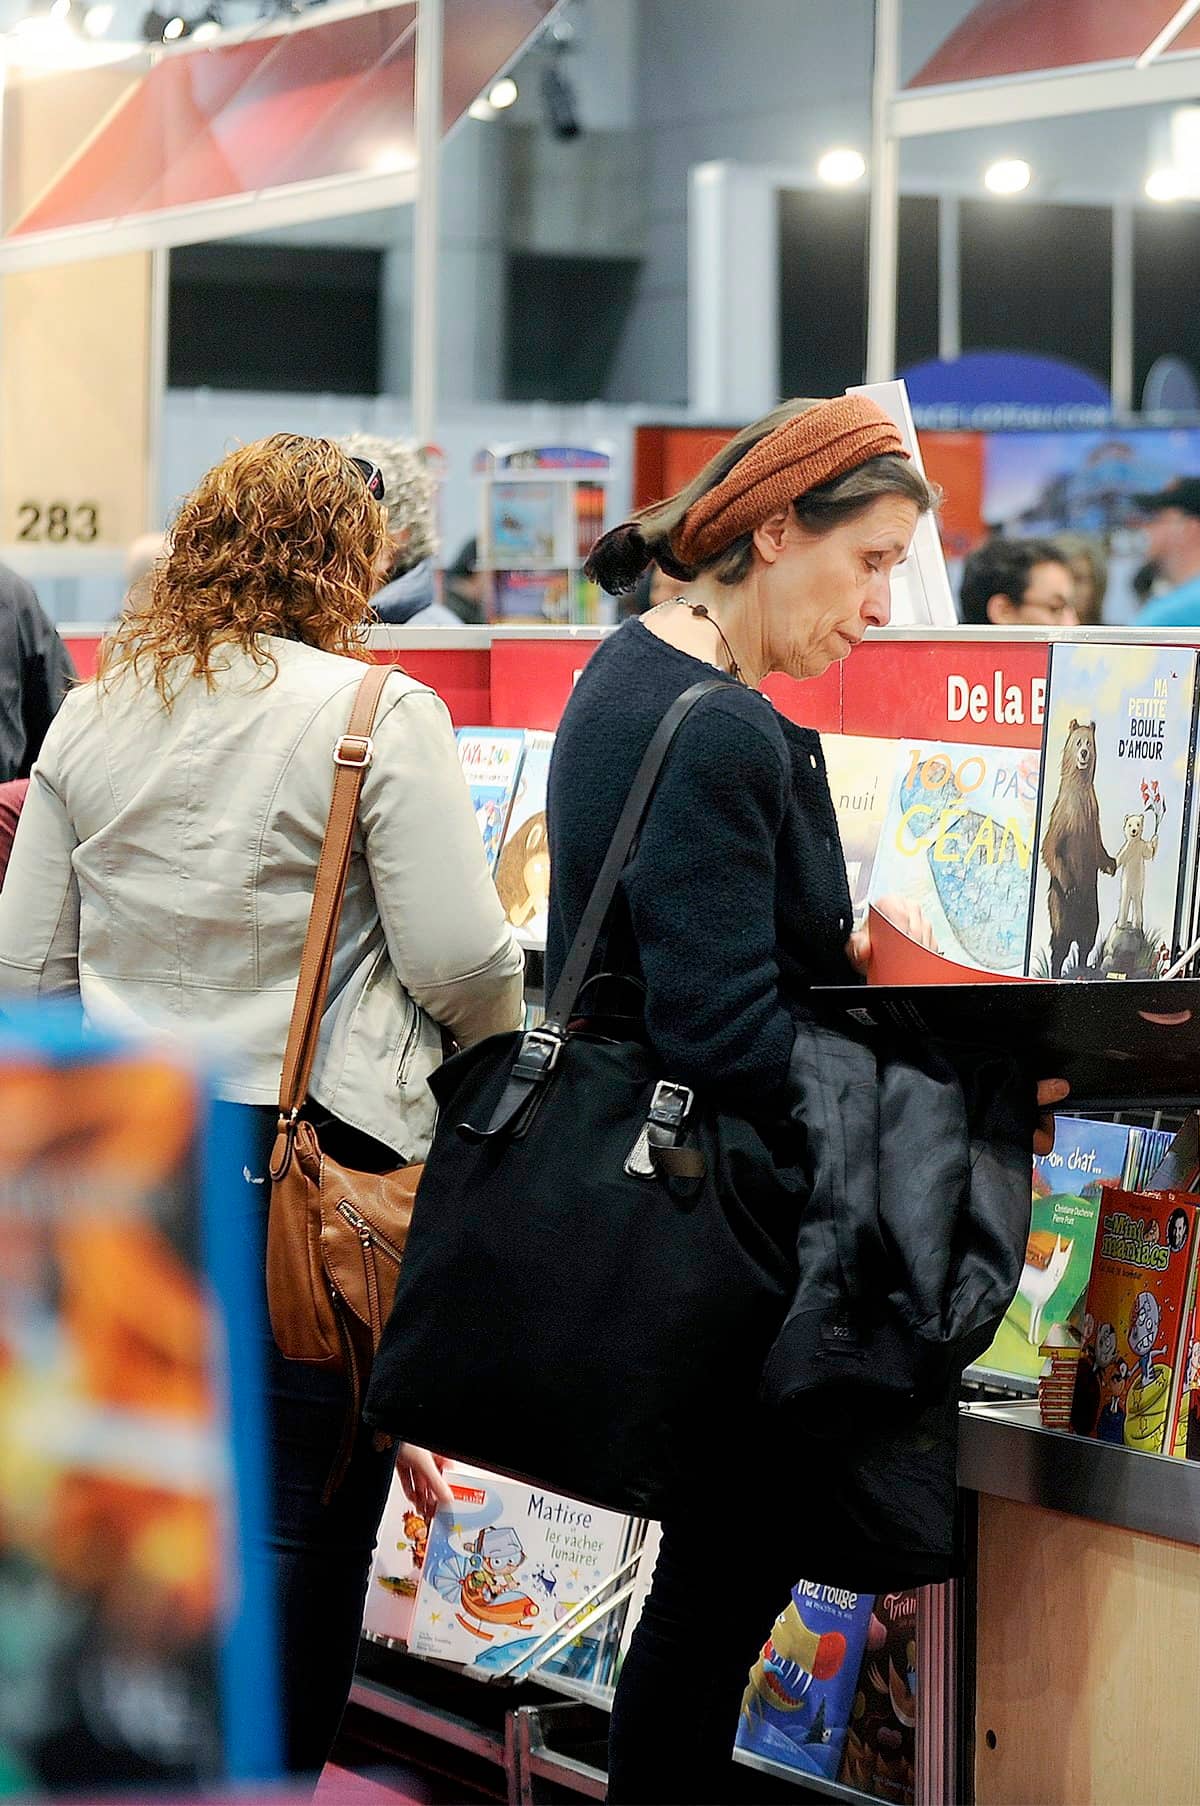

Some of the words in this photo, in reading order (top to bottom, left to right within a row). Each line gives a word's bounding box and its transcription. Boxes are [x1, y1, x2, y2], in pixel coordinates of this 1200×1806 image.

[17, 501, 98, 542] 283
[947, 675, 989, 724] De
[994, 671, 1024, 725] la
[1154, 678, 1168, 697] MA
[1128, 697, 1168, 718] PETITE
[1130, 718, 1165, 738] BOULE
[1118, 739, 1163, 760] D'AMOUR
[905, 750, 987, 794] 100
[992, 768, 1039, 801] PAS
[1067, 1145, 1102, 1174] chat...
[1102, 1236, 1169, 1269] maniacs
[527, 1493, 592, 1529] Matisse
[545, 1527, 561, 1543] les
[564, 1535, 604, 1552] vaches
[551, 1544, 598, 1566] lunaires
[797, 1578, 821, 1600] nez
[821, 1584, 858, 1610] rouge
